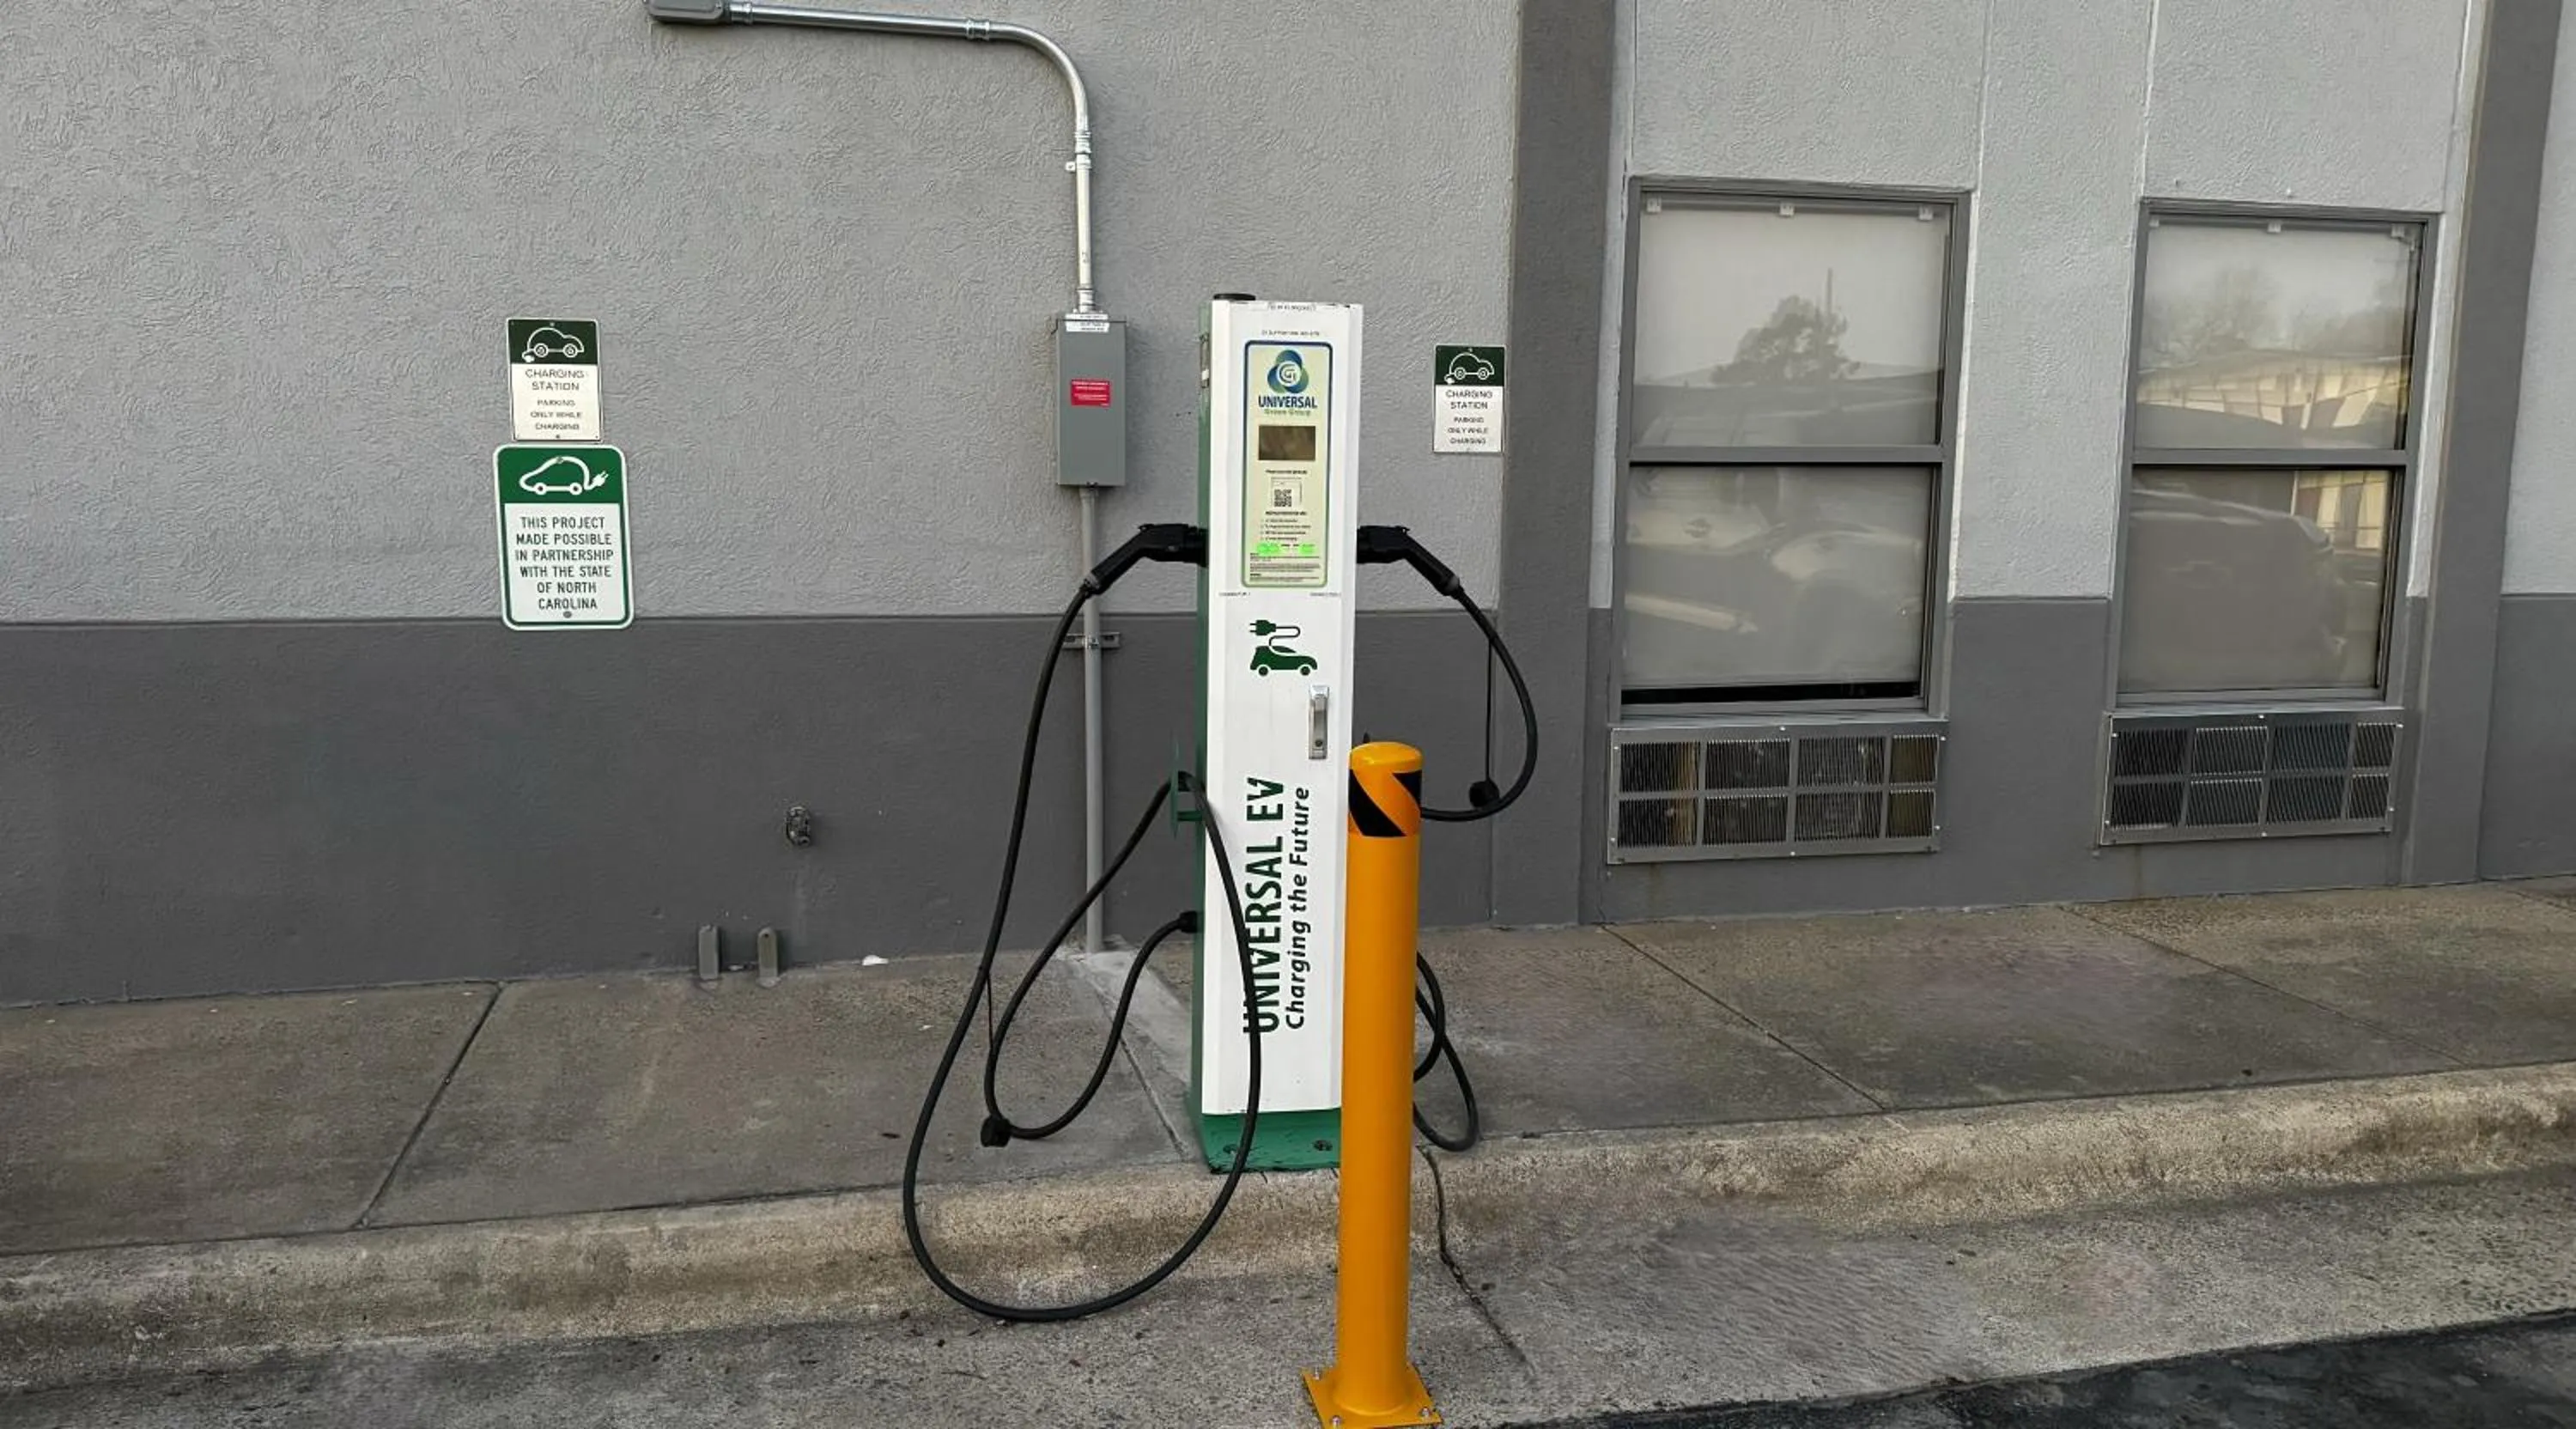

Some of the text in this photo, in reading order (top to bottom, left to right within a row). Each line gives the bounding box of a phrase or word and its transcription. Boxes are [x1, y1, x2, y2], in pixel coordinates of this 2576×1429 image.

[525, 368, 586, 379] CHARGING
[532, 381, 580, 391] STATION
[1445, 389, 1492, 398] CHARGING
[1258, 395, 1318, 409] UNIVERSAL
[1450, 401, 1488, 410] STATION
[520, 516, 605, 529] THIS PROJECT
[516, 533, 612, 545] MADE POSSIBLE
[515, 550, 614, 562] IN PARTNERSHIP
[519, 565, 612, 578] WITH THE STATE
[537, 581, 597, 593] OF NORTH
[538, 598, 598, 610] CAROLINA
[1243, 776, 1284, 1033] UNIVERSAL EV
[1285, 787, 1311, 1030] Charging the Future
